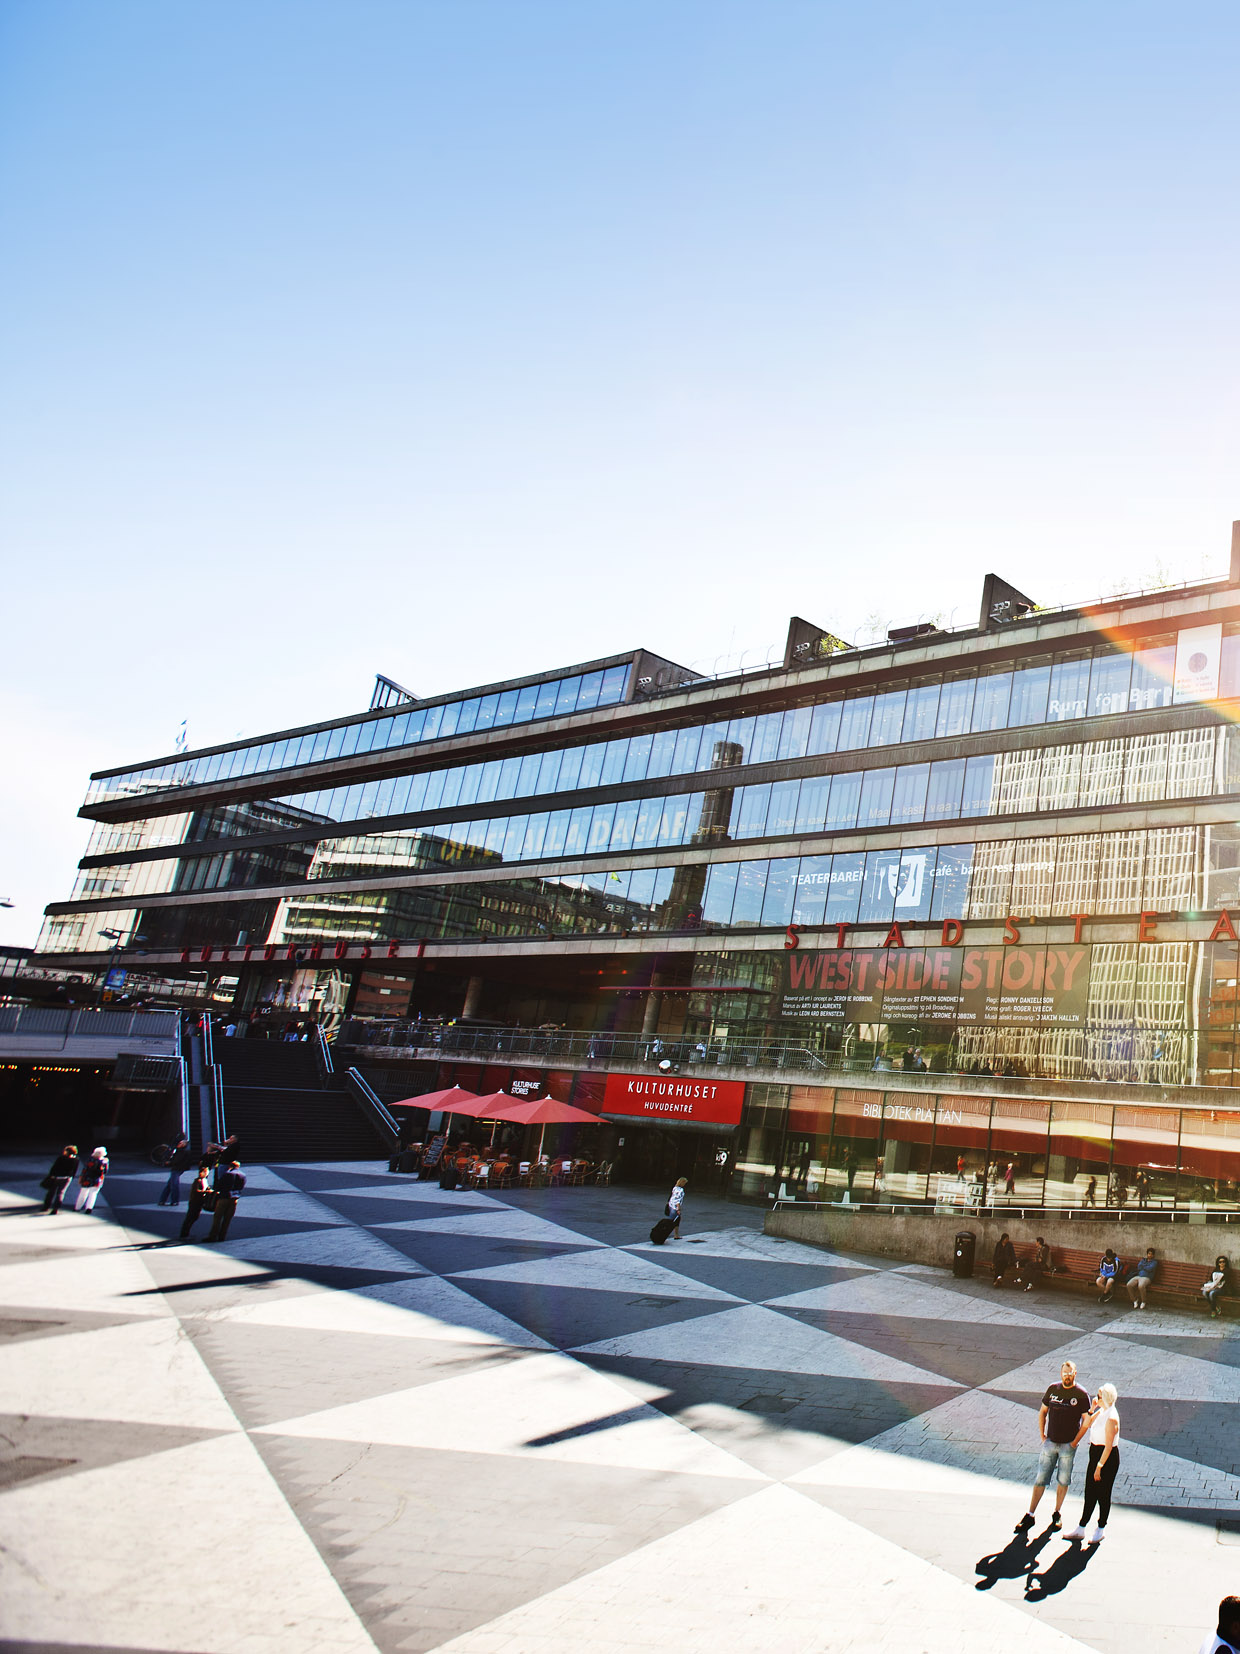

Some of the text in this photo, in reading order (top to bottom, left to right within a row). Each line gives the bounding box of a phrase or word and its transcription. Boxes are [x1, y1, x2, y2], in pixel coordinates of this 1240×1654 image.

[1050, 699, 1086, 714] Rum
[522, 823, 581, 852] ALLA
[791, 870, 868, 886] TEATERBAREN
[930, 865, 951, 877] café
[180, 938, 428, 964] KULTURHUSET
[789, 951, 1085, 991] WEST SIDE STORY
[627, 1081, 718, 1100] KULTURHUSET
[644, 1101, 692, 1114] HUVUDENTRÉ
